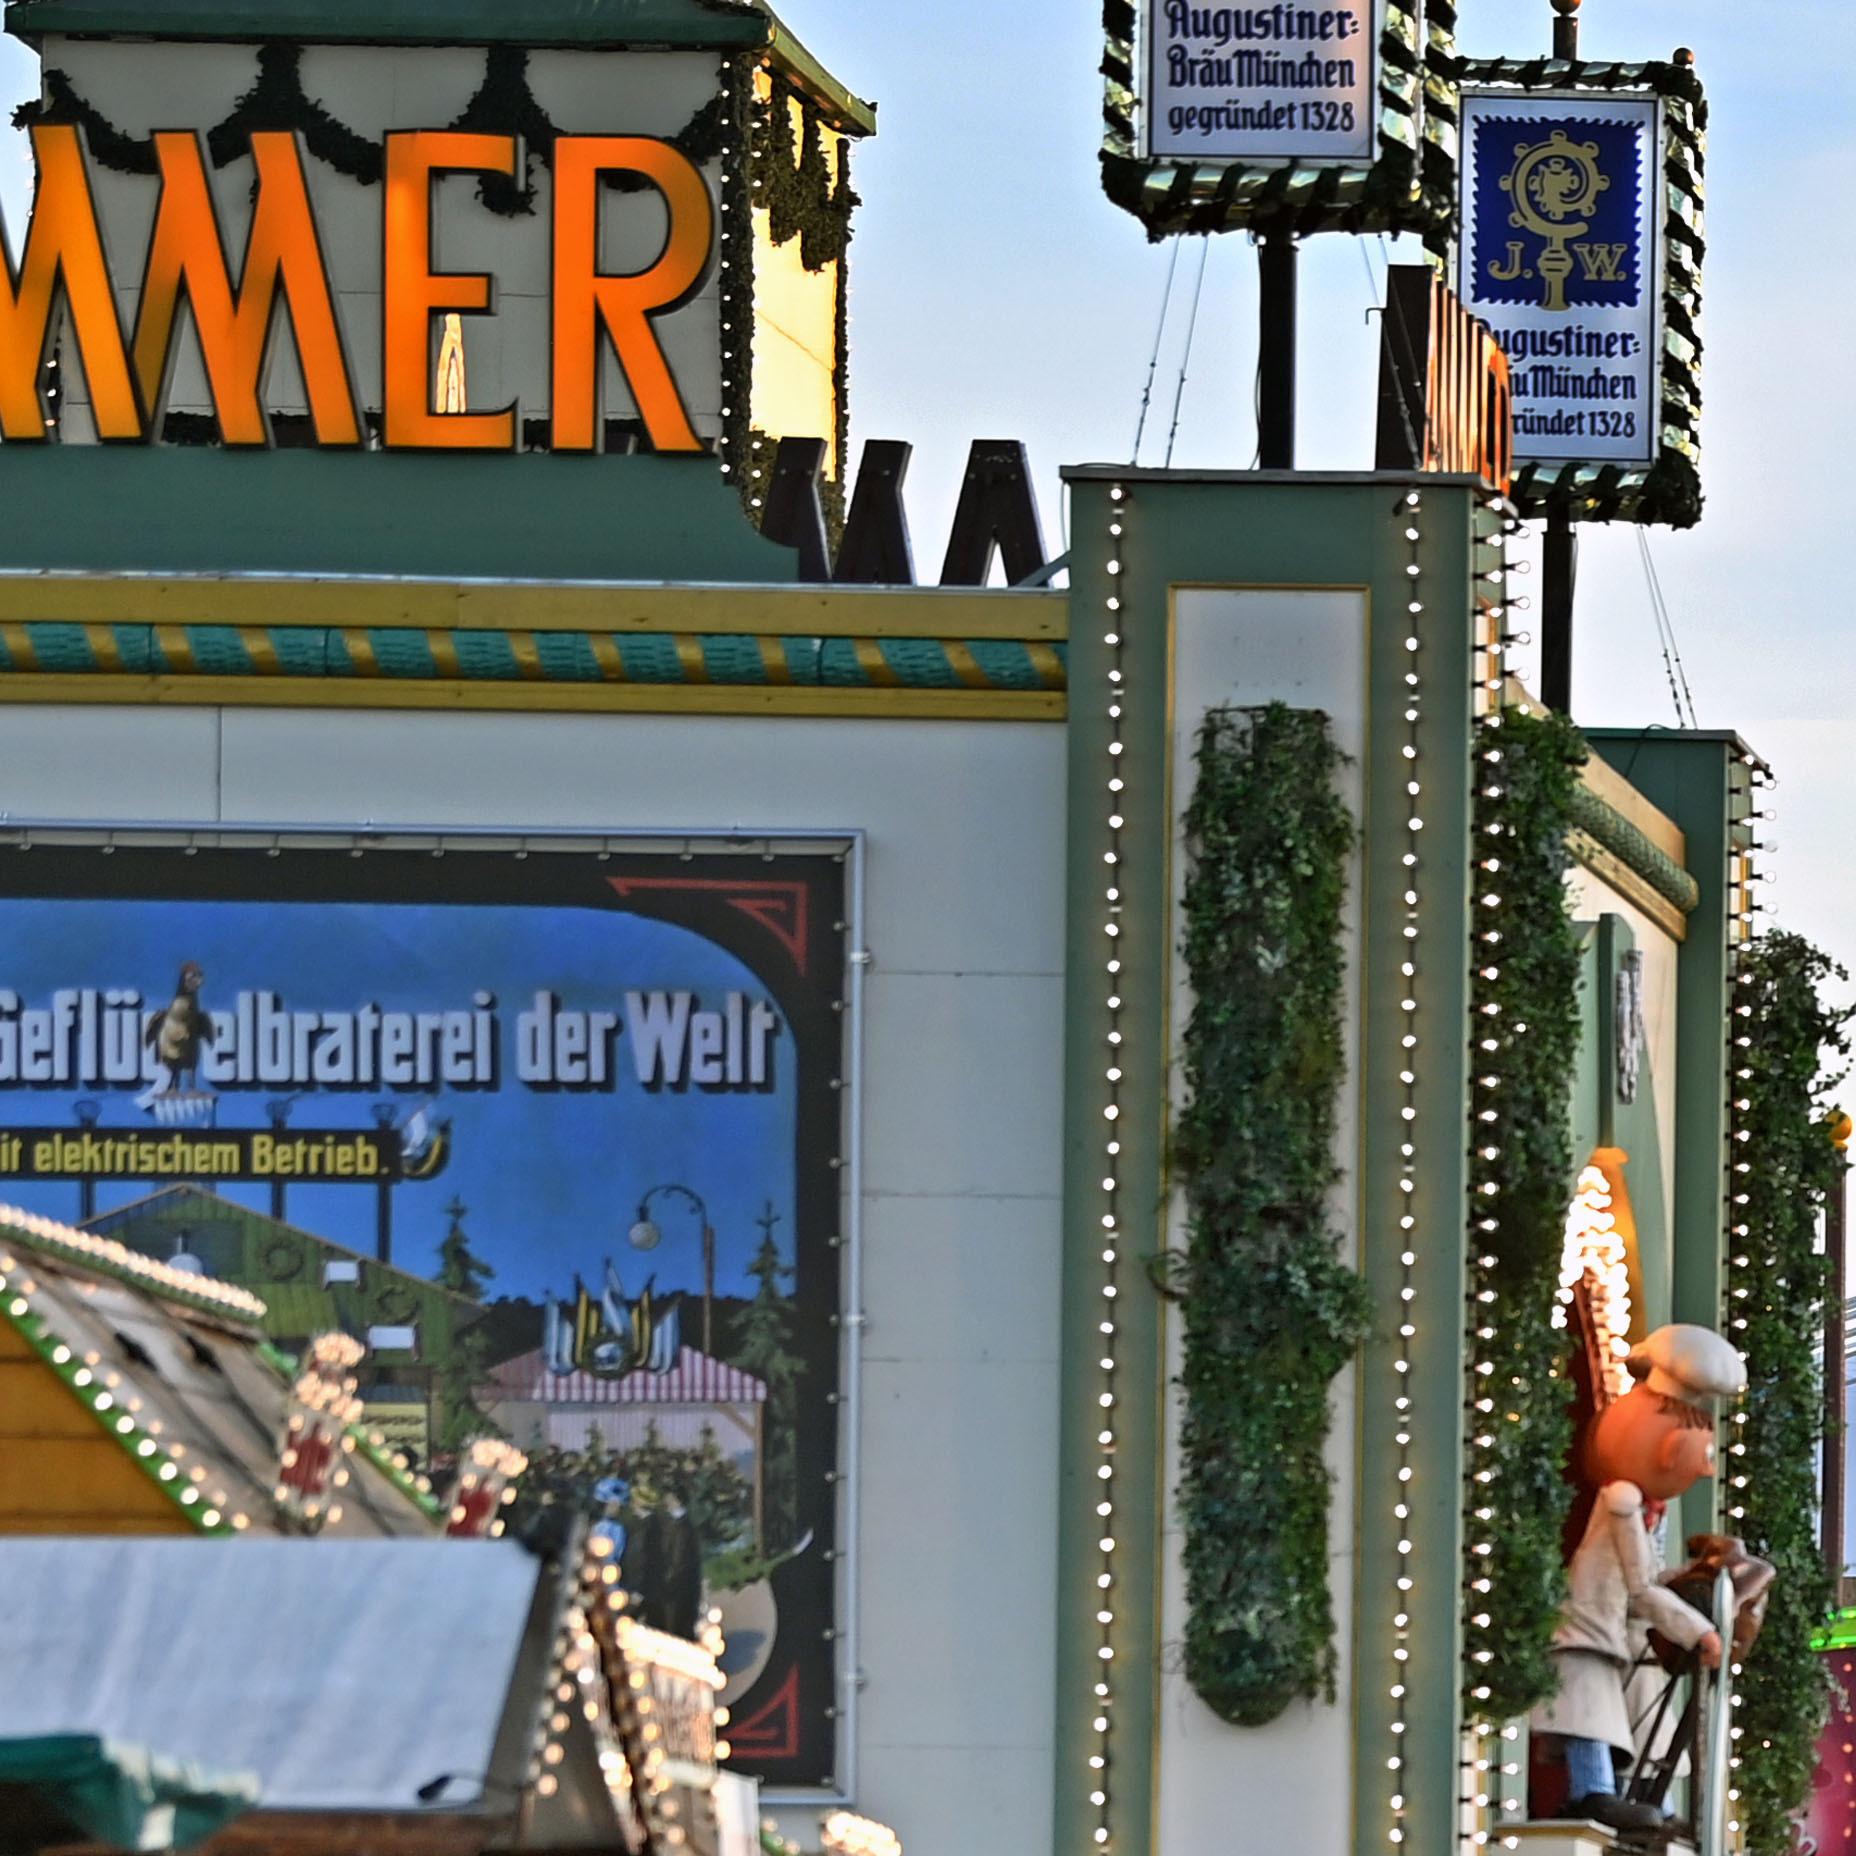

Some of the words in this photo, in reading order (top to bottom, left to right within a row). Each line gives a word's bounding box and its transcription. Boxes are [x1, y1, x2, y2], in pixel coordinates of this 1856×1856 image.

[1168, 99, 1297, 136] gegründet
[1301, 101, 1354, 132] 1328
[1511, 407, 1586, 436] ründet
[1589, 411, 1636, 437] 1328
[516, 990, 623, 1093] der
[624, 990, 782, 1093] Welt
[33, 1133, 240, 1174] elektrischem
